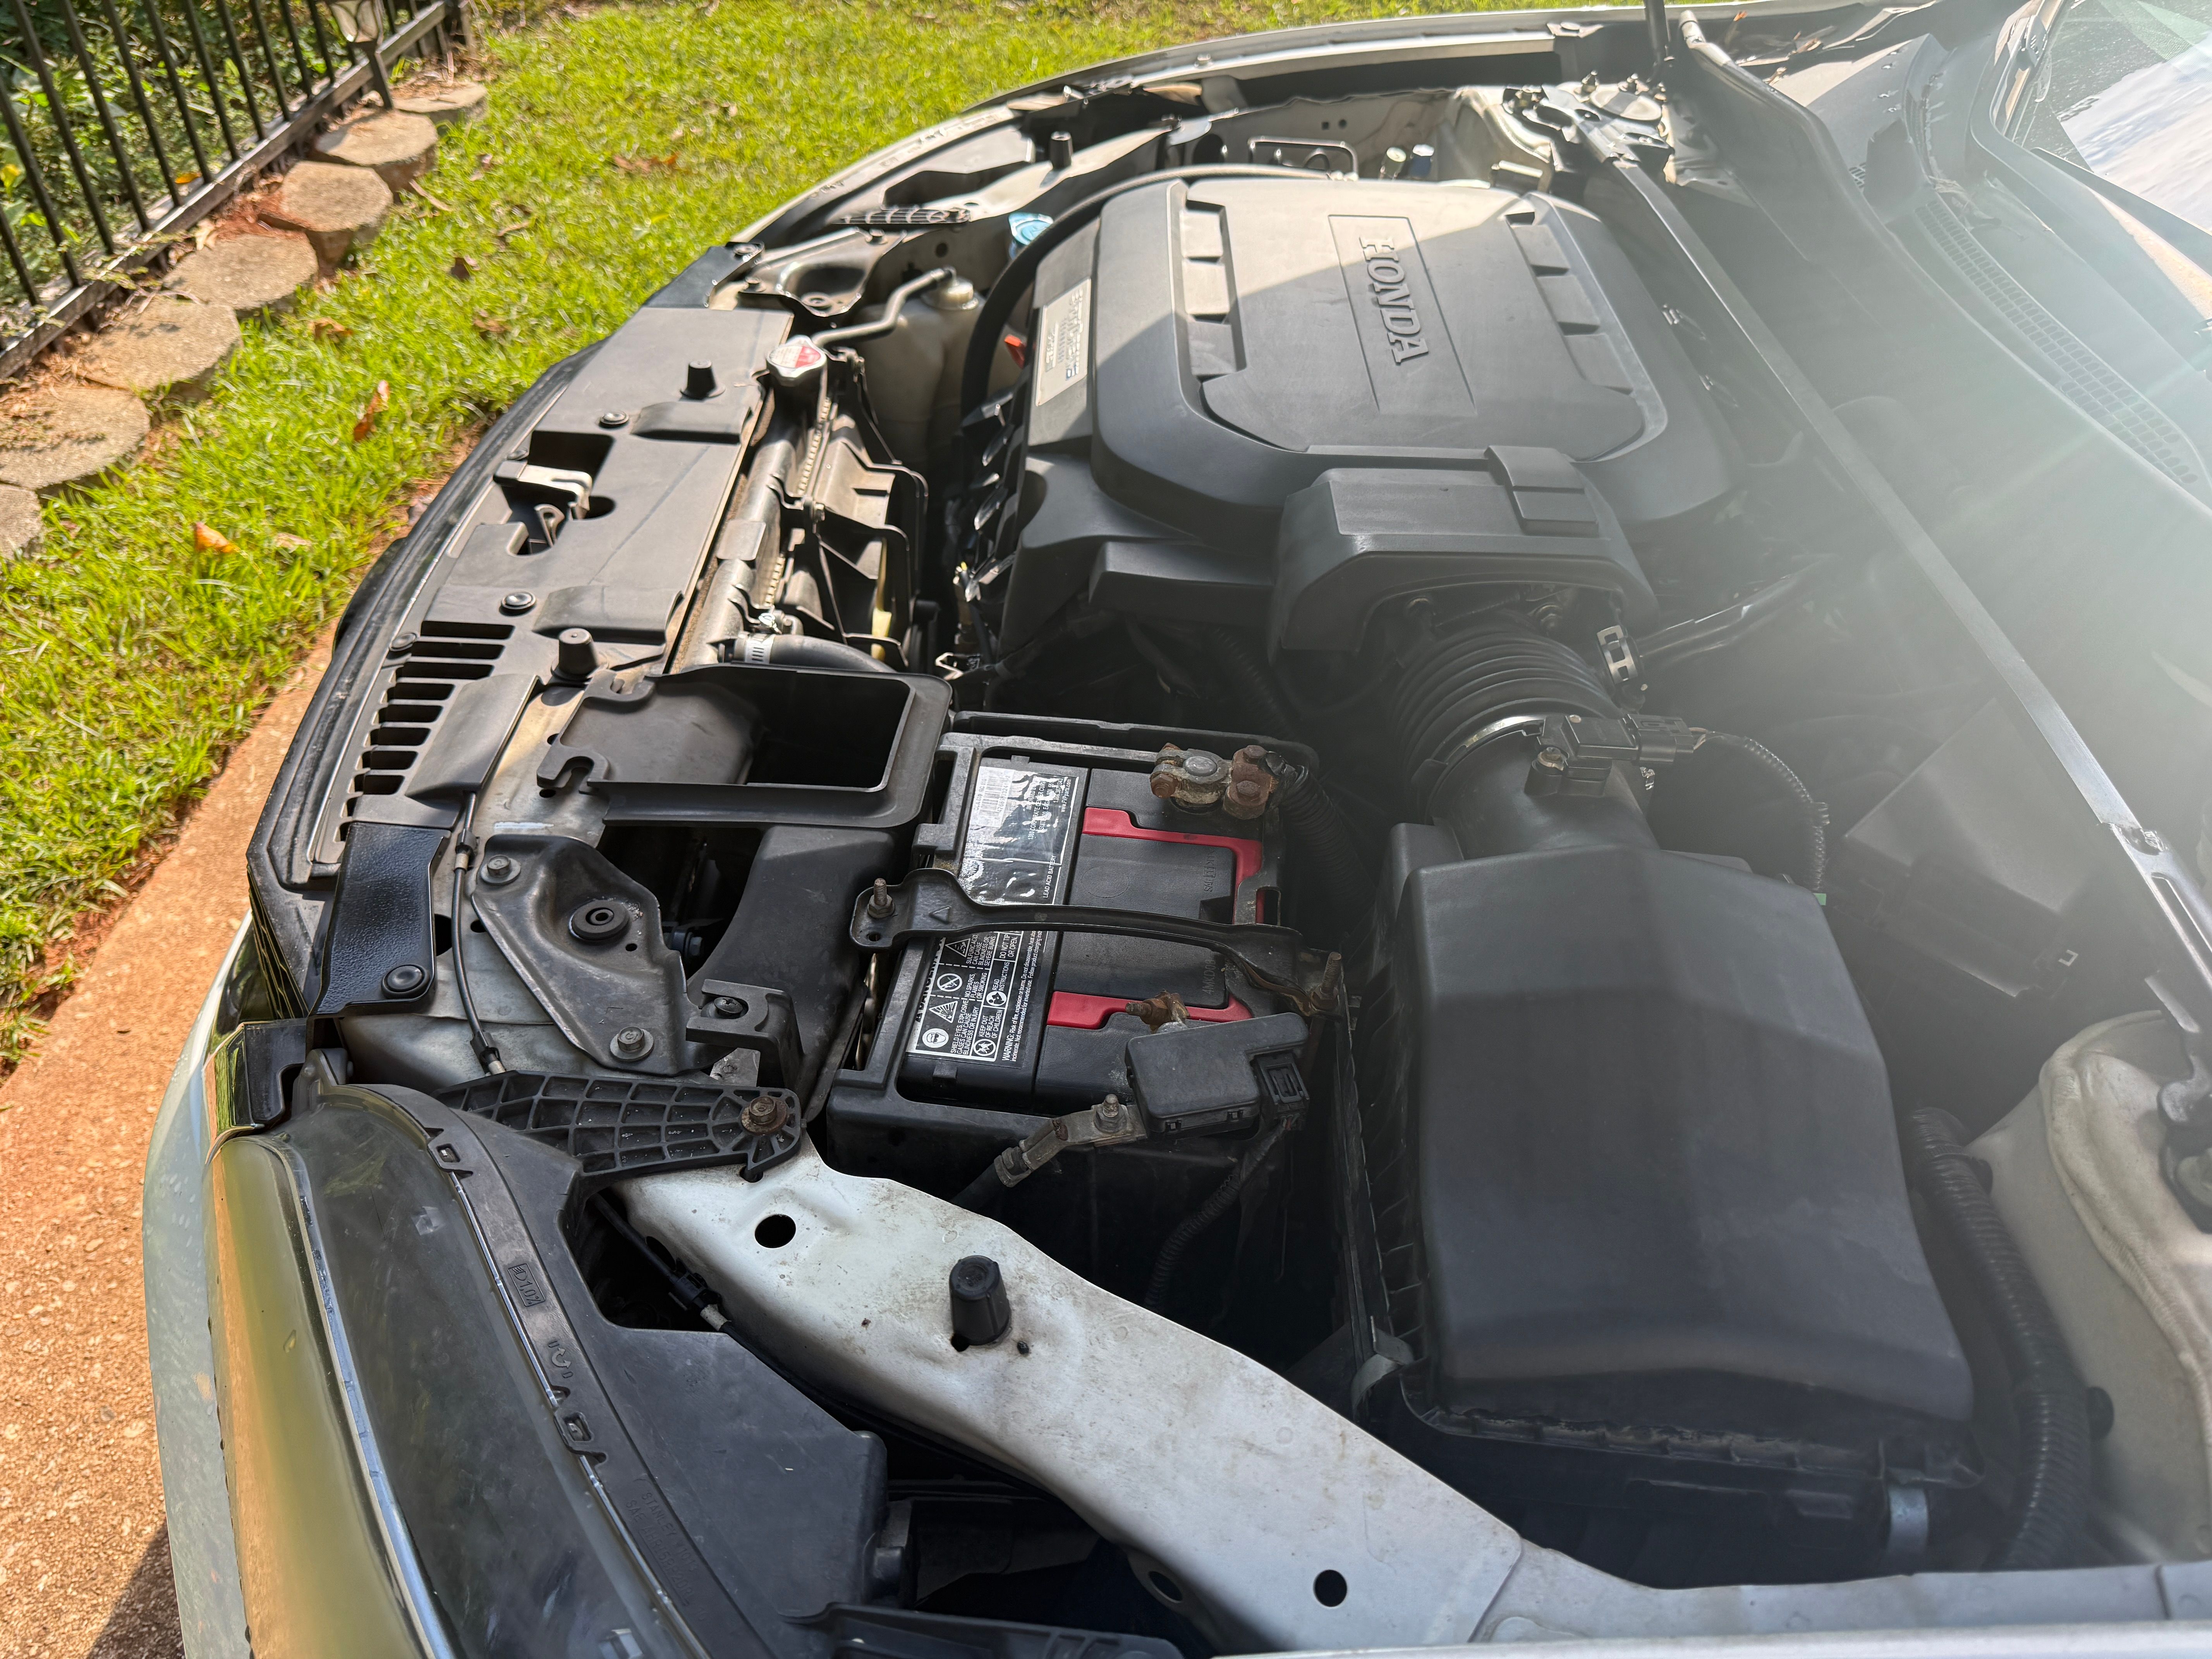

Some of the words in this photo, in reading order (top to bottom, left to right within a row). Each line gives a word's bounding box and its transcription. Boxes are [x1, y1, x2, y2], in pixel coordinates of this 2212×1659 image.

[1359, 236, 1429, 365] HONDA
[1025, 790, 1036, 810] IMORTED
[1061, 779, 1072, 812] www.FVPparts.com
[1030, 806, 1040, 831] CORPRATE
[1035, 791, 1043, 807] CENER
[1048, 855, 1056, 874] BATTERY
[966, 945, 975, 963] SULFURIC
[978, 943, 988, 965] BLINDNESS
[1032, 938, 1042, 953] charging
[984, 951, 993, 966] SEVERE
[967, 973, 976, 990] SPARKS,
[979, 973, 987, 991] SMOKING
[998, 962, 1010, 991] INSTRUCTIONS
[1028, 967, 1037, 978] Follow
[958, 1000, 969, 1023] EXPLOSIVE
[1002, 1034, 1014, 1060] WARNING:
[1015, 995, 1023, 1013] explosion
[1022, 945, 1034, 967] disassemble,
[987, 1016, 995, 1031] REACH
[993, 1010, 1003, 1032] CHILDREN
[1017, 1008, 1027, 1034] recommended
[963, 1030, 974, 1054] BLINDNESS
[1010, 1042, 1020, 1061] incinerate.
[626, 1500, 646, 1522] SAE
[642, 1492, 677, 1536] STANLEY
